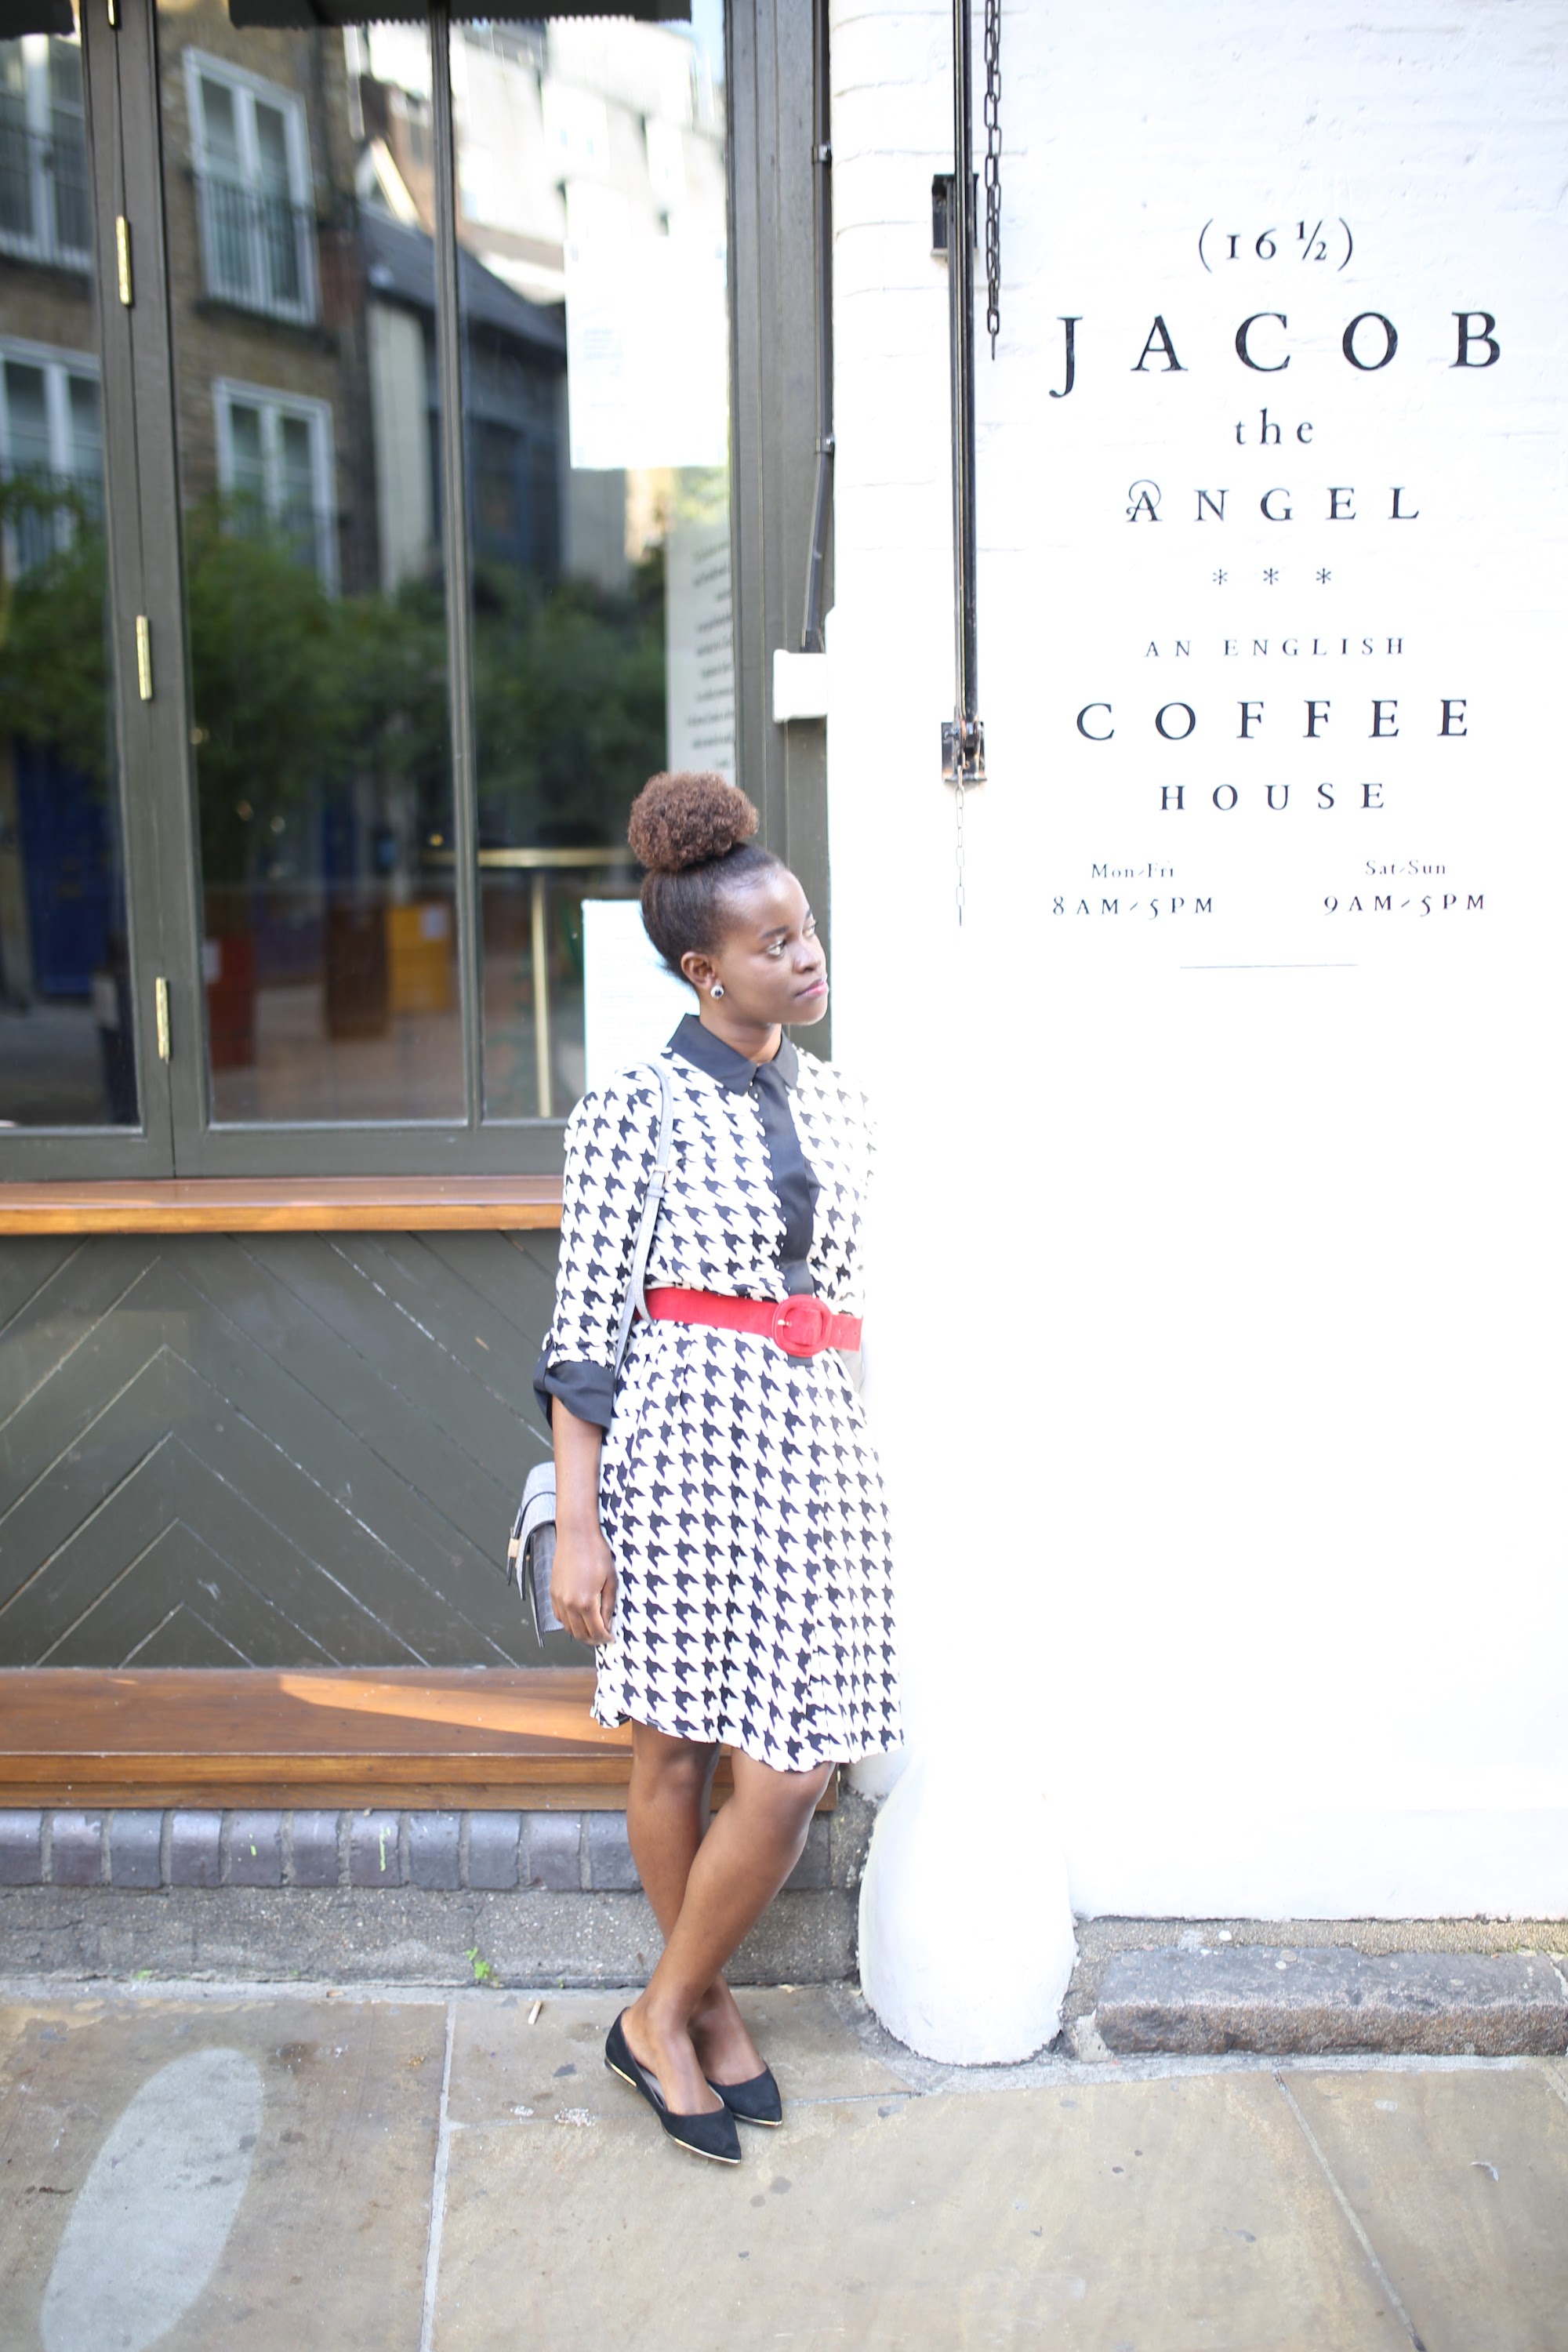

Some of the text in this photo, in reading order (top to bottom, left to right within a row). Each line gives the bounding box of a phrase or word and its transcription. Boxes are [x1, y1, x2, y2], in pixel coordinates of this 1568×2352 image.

[1048, 311, 1501, 398] JACOB
[1234, 408, 1315, 446] the
[1125, 479, 1421, 522] ANGEL
[1144, 637, 1406, 658] AN ENGLISH
[1076, 699, 1468, 741] COFFEE
[1160, 782, 1385, 811] HOUSE
